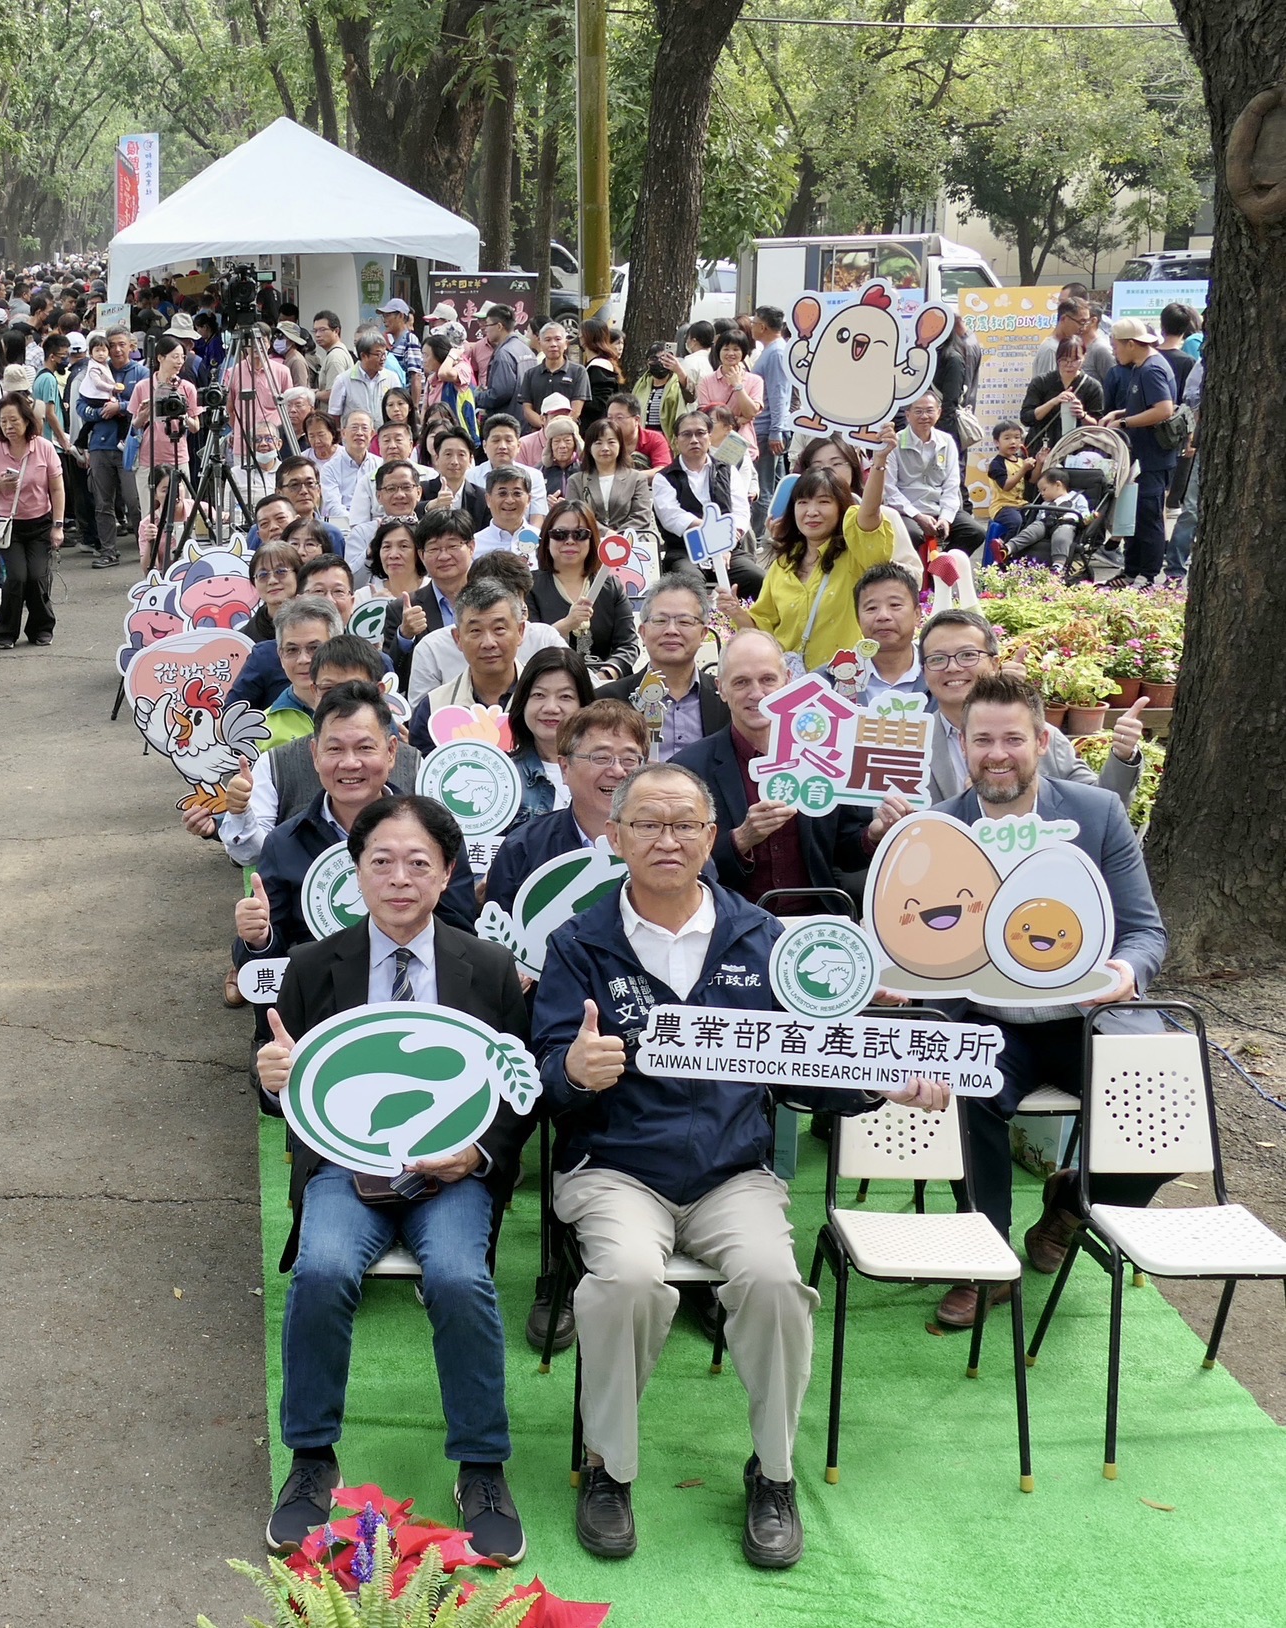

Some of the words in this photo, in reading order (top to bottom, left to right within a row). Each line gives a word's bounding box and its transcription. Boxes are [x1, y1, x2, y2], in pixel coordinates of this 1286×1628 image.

[154, 659, 232, 684] 從牧場
[770, 776, 828, 806] 教育
[465, 817, 494, 829] RESEARCH
[495, 793, 509, 819] INSTITUTE
[316, 904, 329, 928] TAIWAN
[253, 968, 285, 994] 農
[637, 975, 656, 1008] 南部聯
[707, 973, 762, 986] 行政院
[783, 969, 792, 990] TAIWAN
[790, 990, 818, 1011] LIVESTOCK
[820, 999, 850, 1011] RESEARCH
[851, 974, 866, 999] INSTITUTE
[646, 1012, 998, 1066] 農業部畜產試驗所
[648, 1053, 702, 1071] TAIWAN
[707, 1057, 787, 1077] LIVESTOCK
[791, 1063, 873, 1083] RESEARCH
[959, 1074, 993, 1090] MOA
